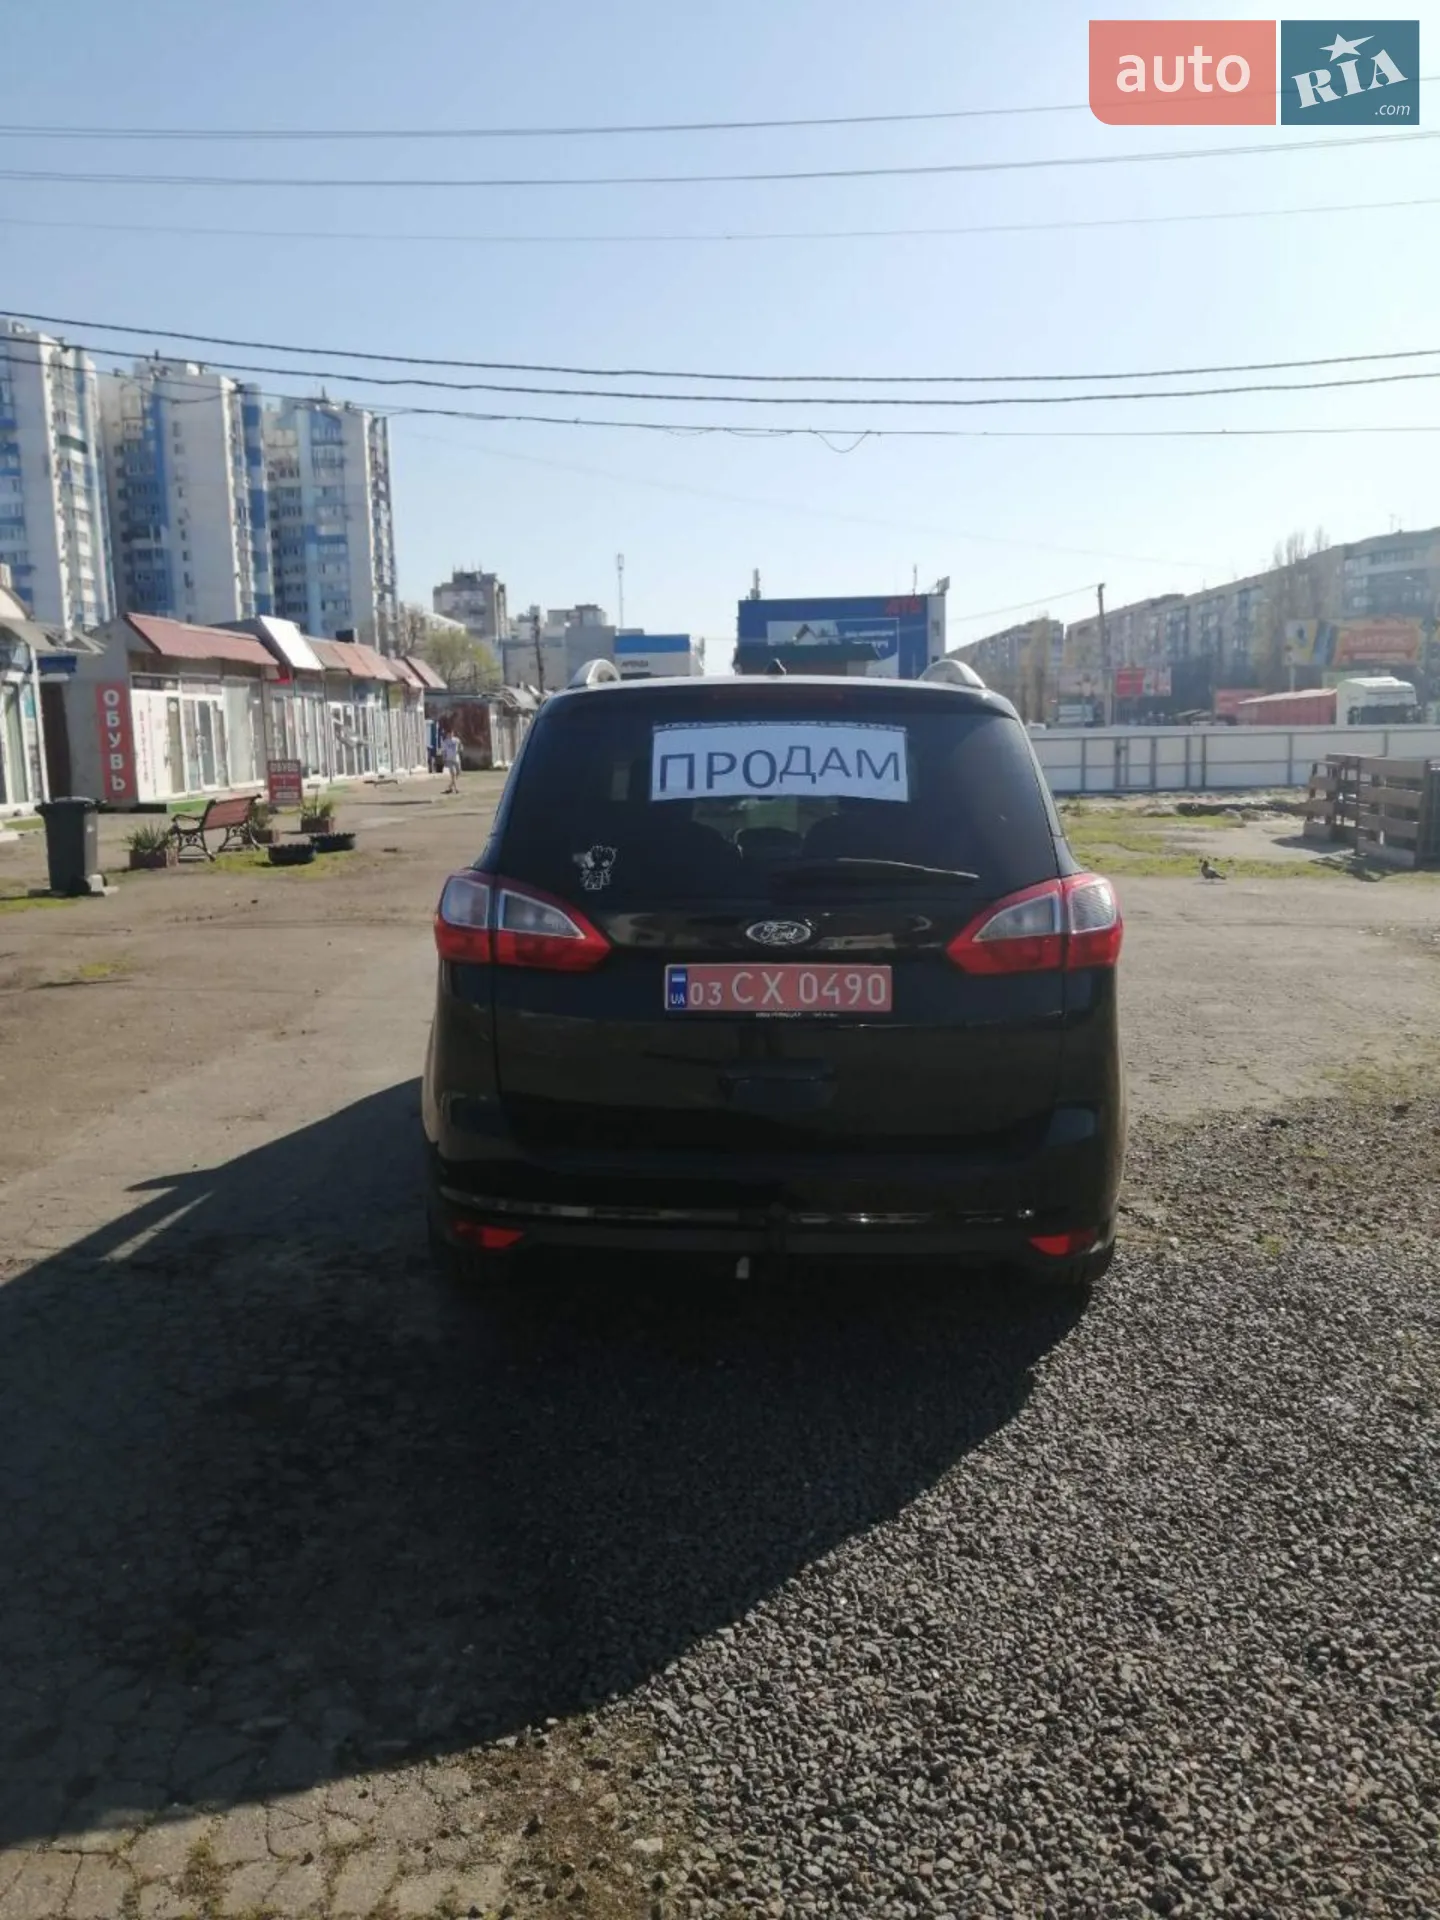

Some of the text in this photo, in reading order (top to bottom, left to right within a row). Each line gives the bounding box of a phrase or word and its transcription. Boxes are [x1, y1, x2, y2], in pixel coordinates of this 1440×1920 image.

[103, 689, 126, 792] ОБУВЬ
[659, 745, 900, 792] ПРОДАМ
[760, 924, 798, 940] Ford
[671, 993, 685, 1004] UA
[690, 981, 722, 1005] 03
[799, 972, 886, 1005] 0490
